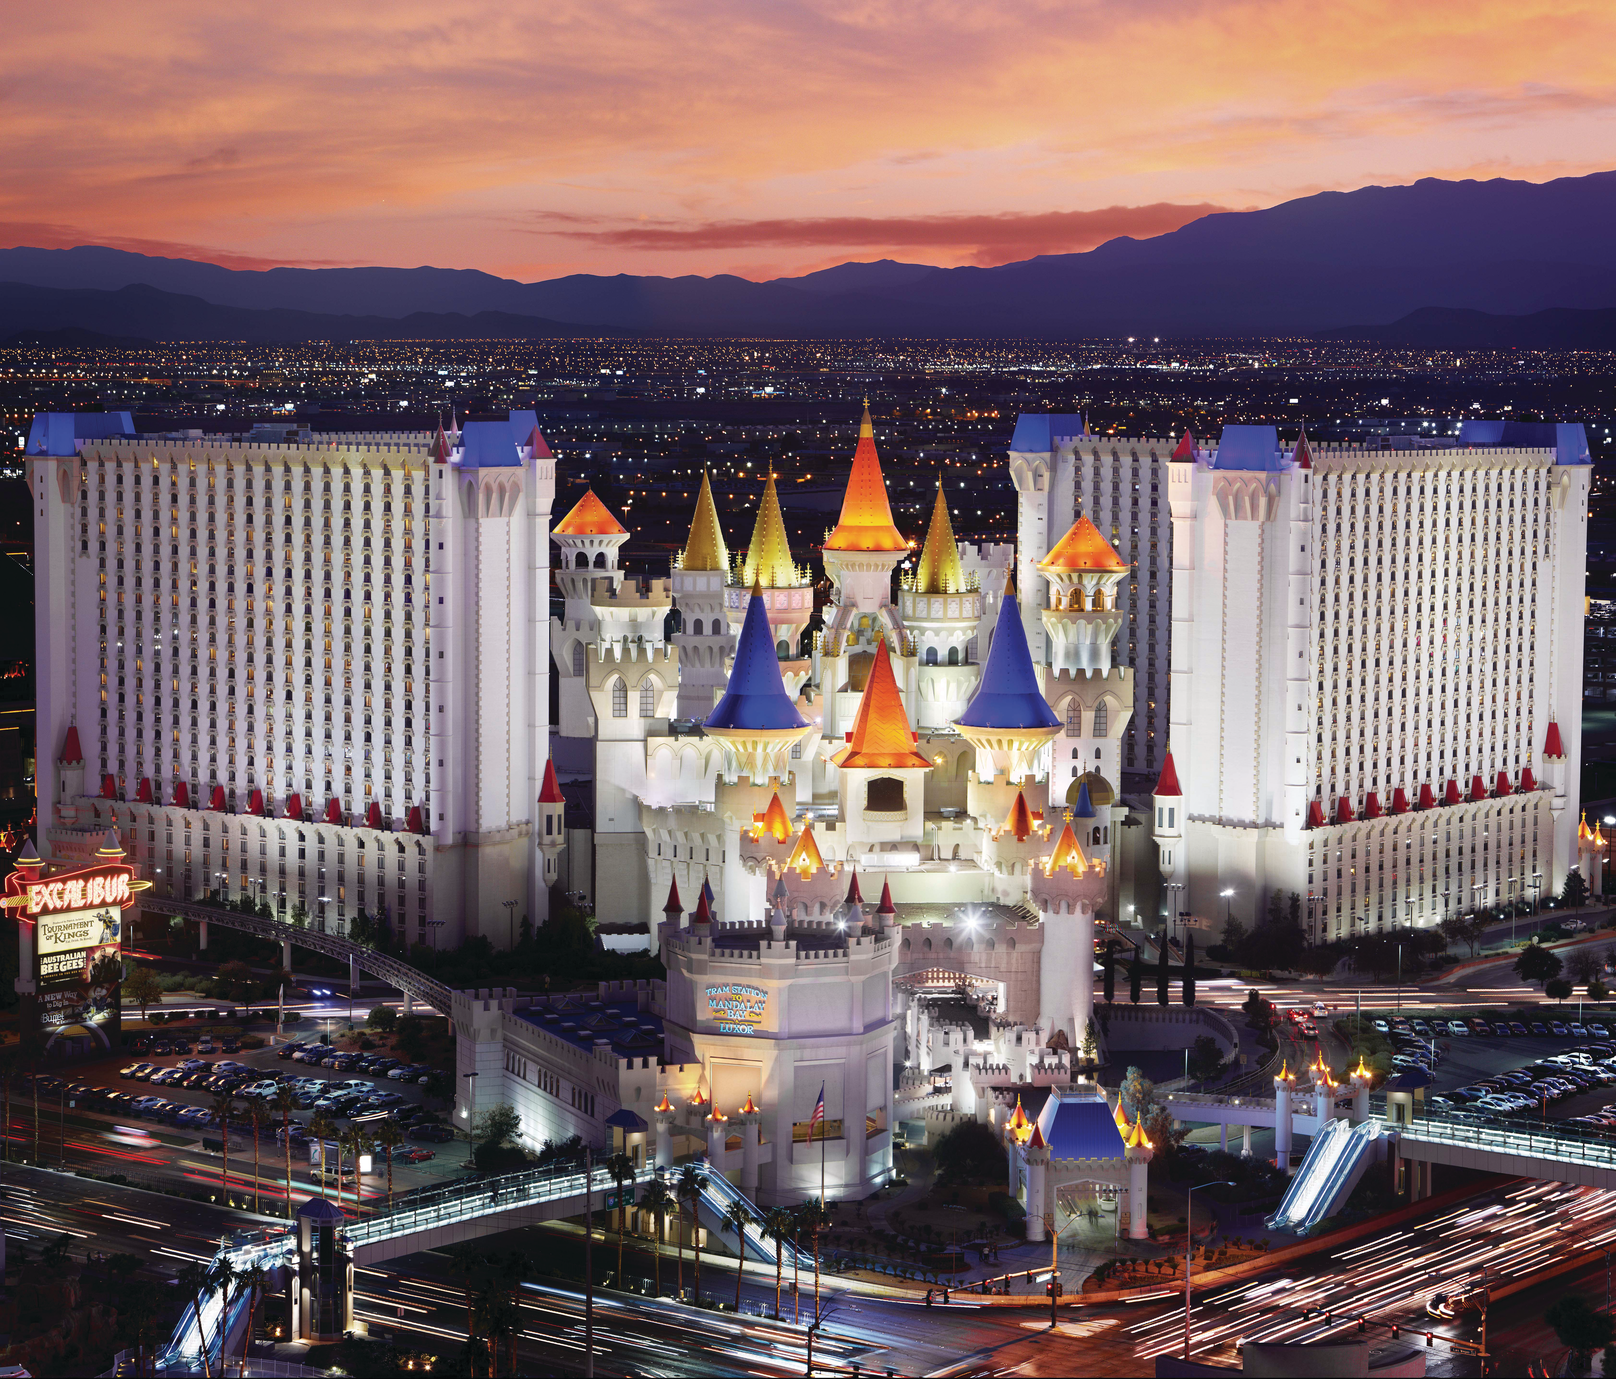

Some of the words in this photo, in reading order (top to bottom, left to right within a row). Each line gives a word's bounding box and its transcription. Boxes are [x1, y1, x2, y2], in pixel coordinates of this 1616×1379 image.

[31, 873, 130, 913] EXCALIBUR
[41, 920, 94, 936] TOURNAMENT
[54, 930, 90, 944] KINGS
[43, 951, 87, 964] AUSTRALIAN
[40, 962, 60, 976] BEE
[59, 958, 84, 972] GEES
[38, 995, 43, 1003] A
[44, 992, 63, 1002] NEW
[705, 986, 730, 996] TRAM
[731, 985, 768, 1001] STATION
[52, 1000, 62, 1008] Dig
[708, 999, 765, 1011] MANDALAY
[727, 1009, 747, 1020] BAY
[720, 1023, 755, 1035] LUXOR
